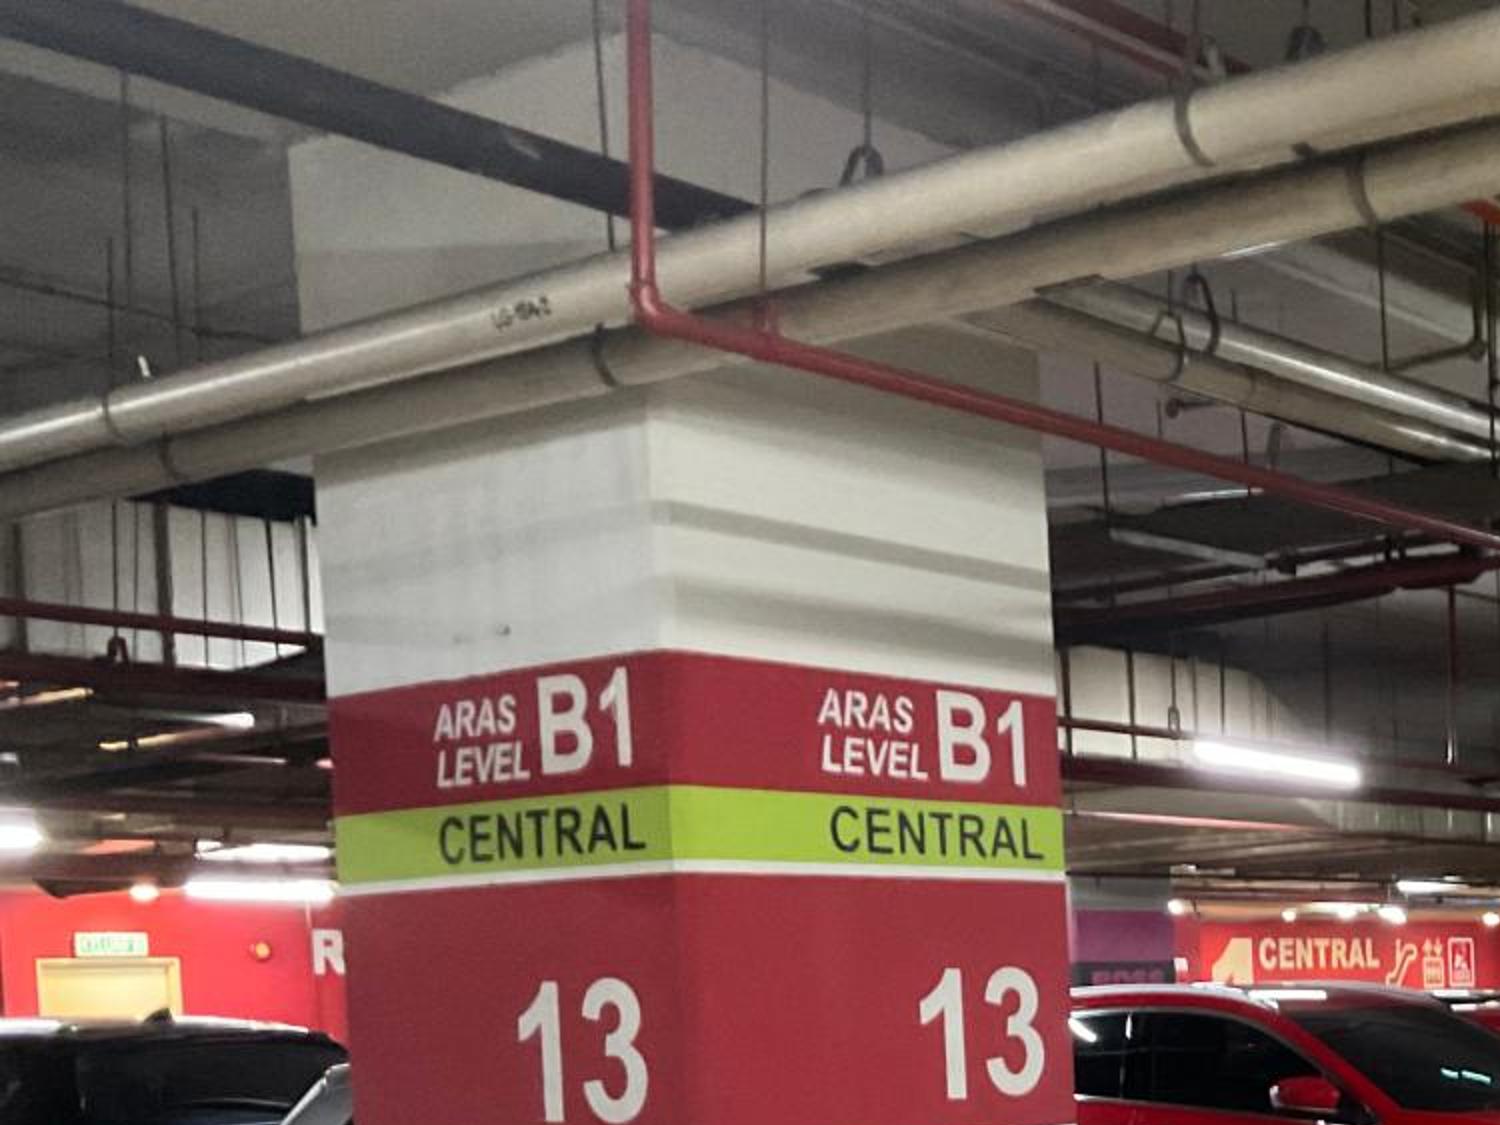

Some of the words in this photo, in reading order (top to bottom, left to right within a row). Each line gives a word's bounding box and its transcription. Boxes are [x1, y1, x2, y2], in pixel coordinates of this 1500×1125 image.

[434, 694, 516, 742] ARAS
[536, 666, 633, 777] B1
[817, 688, 914, 734] ARAS
[935, 690, 1026, 787] B1
[436, 742, 531, 789] LEVEL
[821, 734, 928, 781] LEVEL
[438, 803, 646, 865] CENTRAL
[829, 804, 1045, 861] CENTRAL
[1258, 937, 1381, 970] CENTRAL
[517, 977, 648, 1124] 13
[919, 966, 1045, 1100] 13
